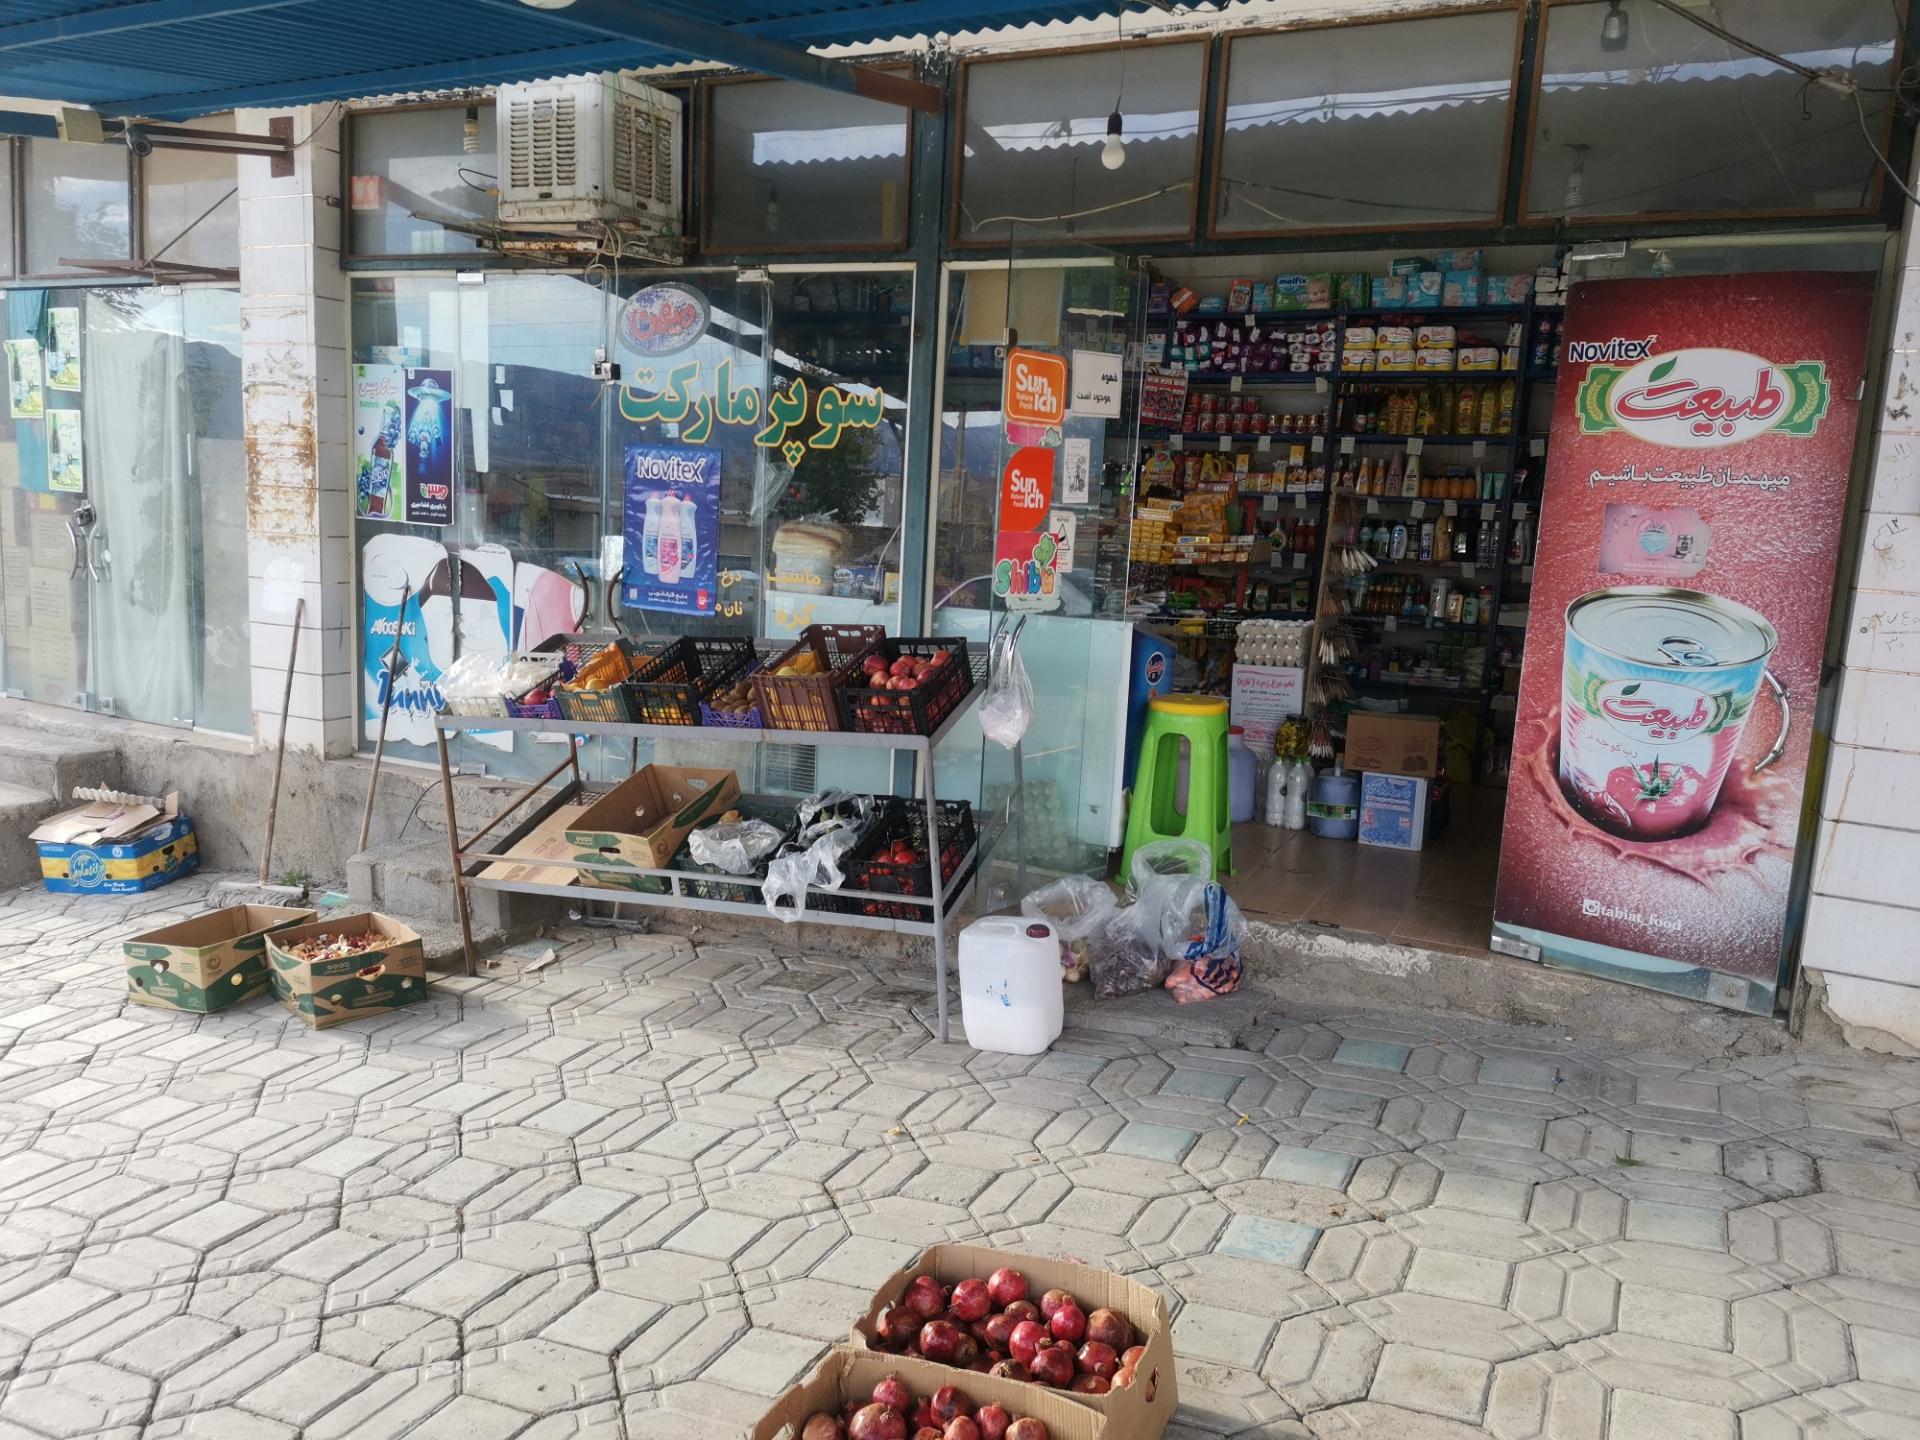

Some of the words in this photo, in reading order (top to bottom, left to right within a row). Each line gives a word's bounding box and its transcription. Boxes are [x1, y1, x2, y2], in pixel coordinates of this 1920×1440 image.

[1568, 336, 1655, 363] Novitex
[1015, 363, 1048, 393] Sun
[1076, 391, 1092, 400] است
[1092, 394, 1111, 404] موجود
[1615, 360, 1784, 437] طبیعت
[635, 455, 706, 483] Novitex
[1010, 468, 1037, 494] Sun
[1588, 465, 1649, 490] باشیم
[1648, 465, 1715, 490] طبیعت
[1714, 467, 1791, 489] میهمان
[720, 567, 743, 588] دوغ
[995, 559, 1055, 596] Shiba
[724, 600, 743, 617] نان
[1600, 687, 1710, 741] طبیعت
[1600, 906, 1682, 931] tabiat_food
